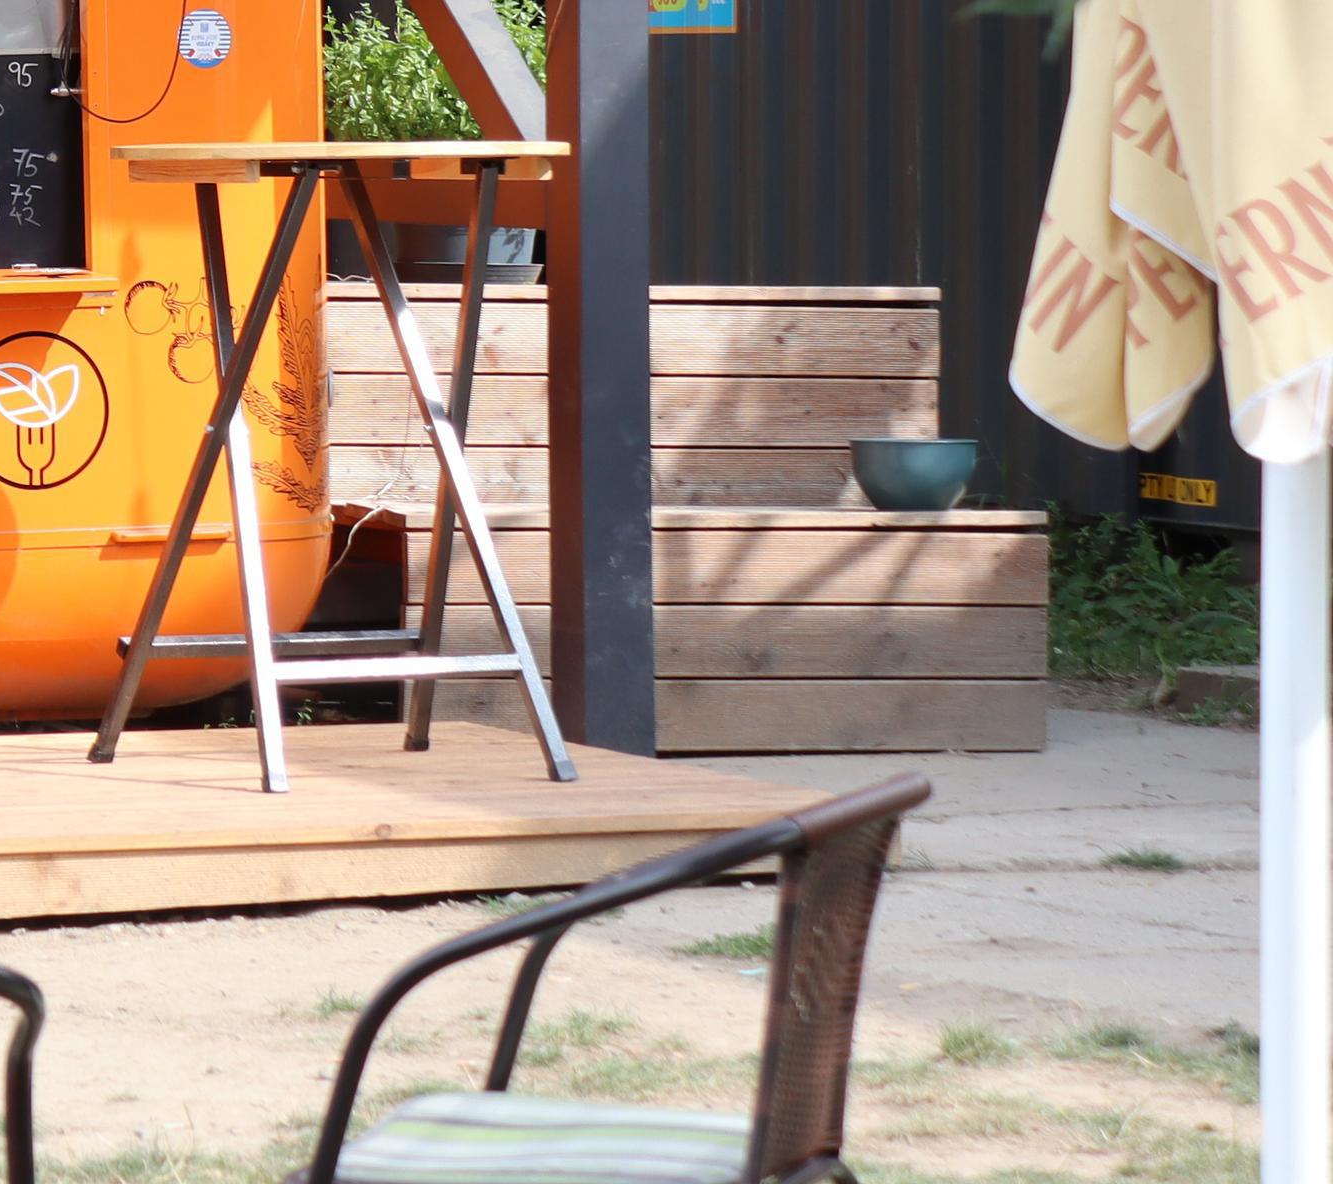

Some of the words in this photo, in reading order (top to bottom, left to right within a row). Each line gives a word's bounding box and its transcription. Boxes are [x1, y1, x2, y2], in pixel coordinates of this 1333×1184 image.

[8, 61, 39, 88] 95
[12, 148, 45, 177] 75
[9, 183, 43, 206] 75
[10, 207, 41, 228] 42
